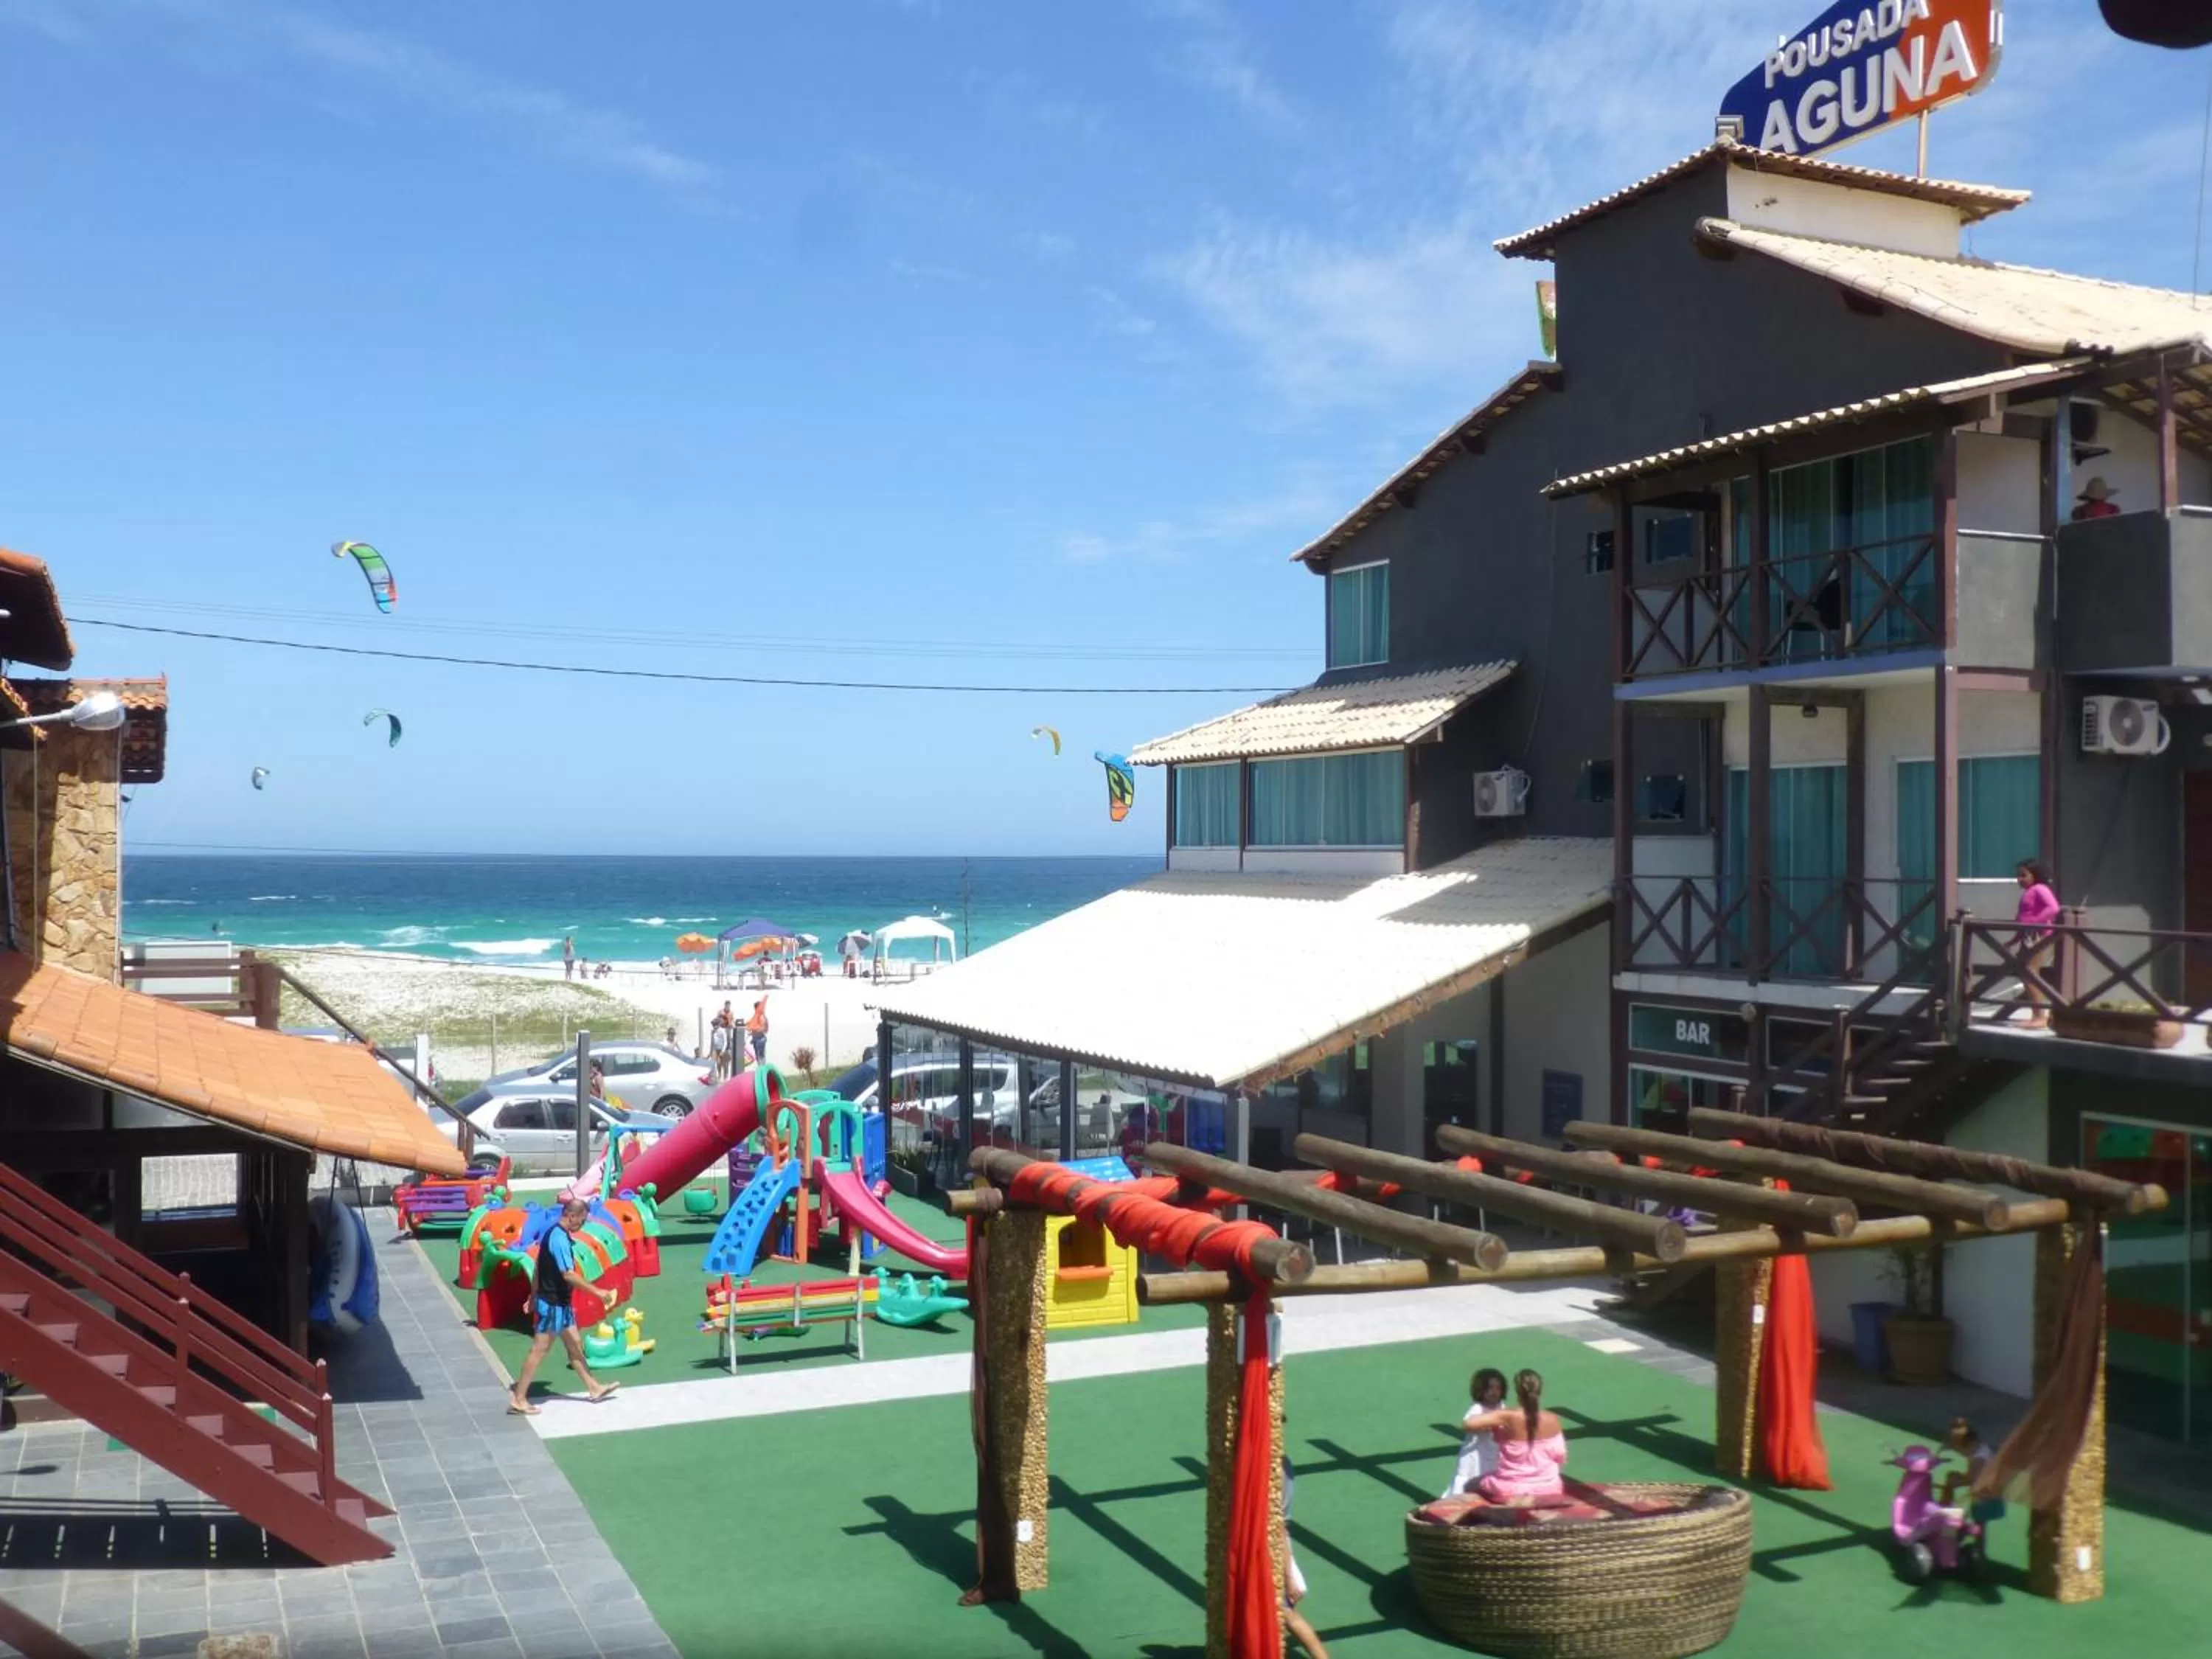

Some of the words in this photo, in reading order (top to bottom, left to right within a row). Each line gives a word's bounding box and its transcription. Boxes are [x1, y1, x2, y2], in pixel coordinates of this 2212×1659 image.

[1760, 20, 1978, 153] AGUNA
[1764, 0, 1930, 88] POUSADA
[1675, 1020, 1711, 1045] BAR
